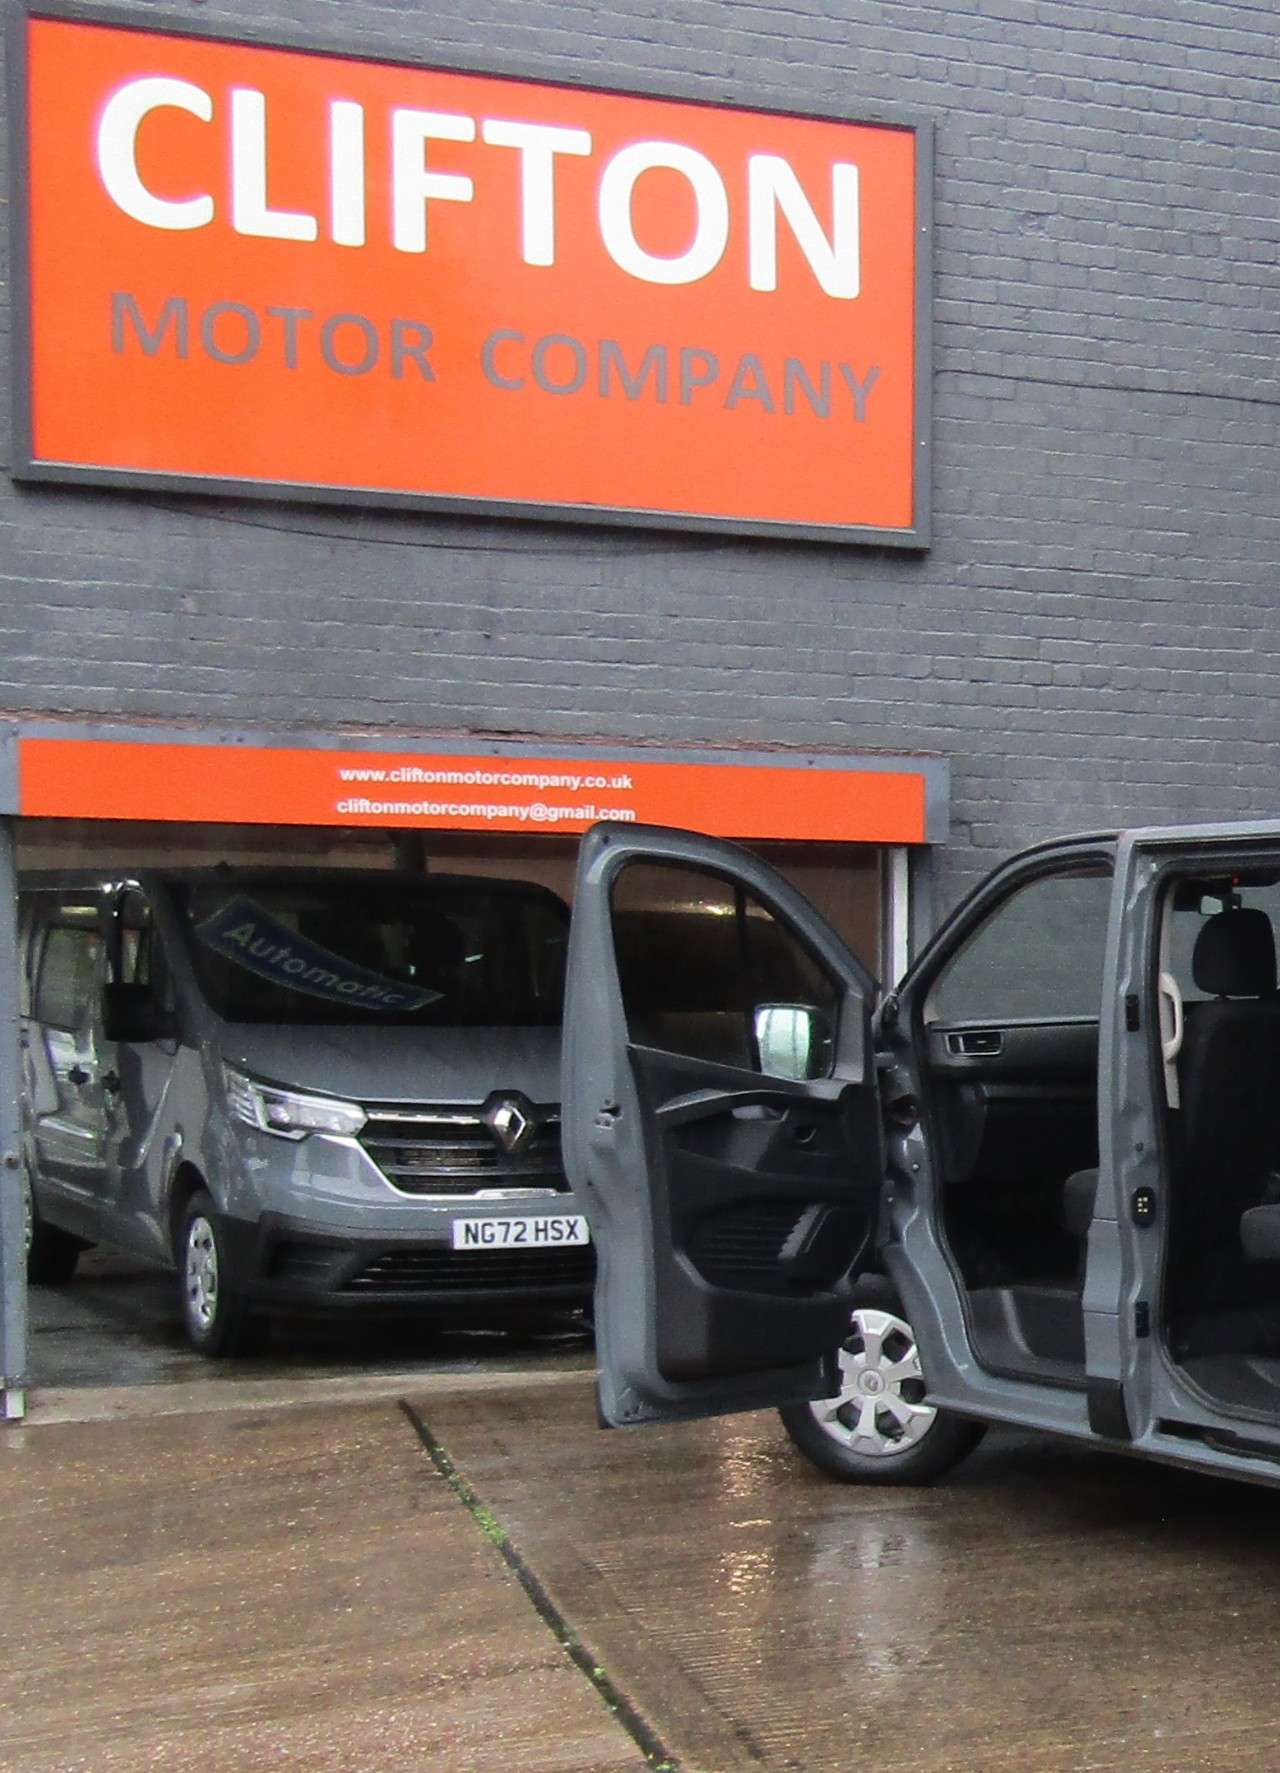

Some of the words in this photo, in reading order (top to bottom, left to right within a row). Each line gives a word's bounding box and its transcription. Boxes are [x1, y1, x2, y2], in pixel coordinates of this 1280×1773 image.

[97, 77, 861, 300] CLIFTON
[110, 292, 437, 383] MOTOR
[479, 328, 881, 423] COMPANY
[339, 767, 633, 791] www.cliftonmotorcompany.co.uk
[336, 798, 636, 821] cliftonmotorcompany@gmail.com
[222, 922, 405, 1005] Automatic
[464, 1221, 528, 1244] NG72
[534, 1219, 579, 1241] HSX
